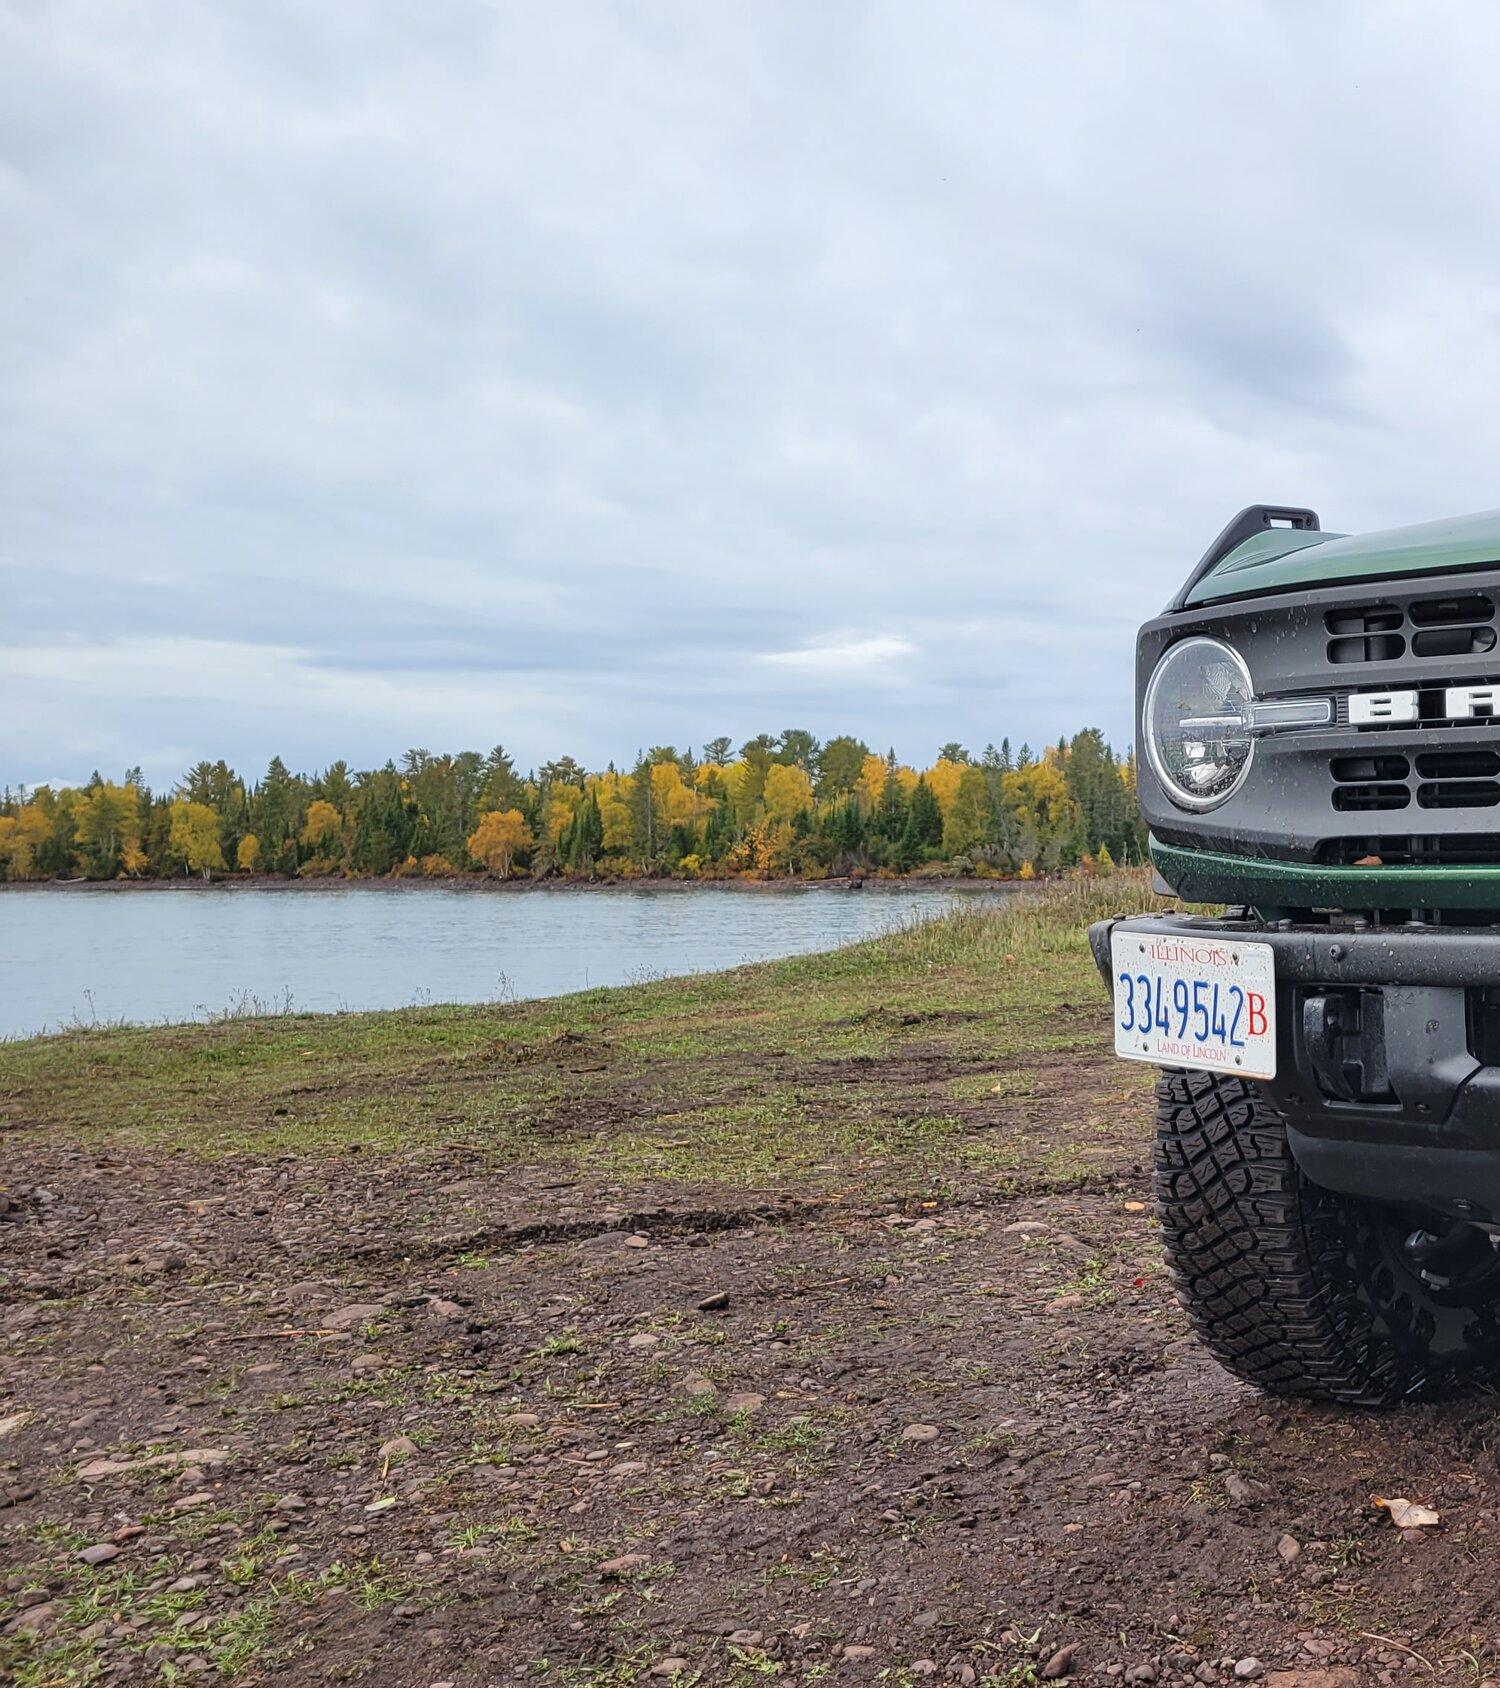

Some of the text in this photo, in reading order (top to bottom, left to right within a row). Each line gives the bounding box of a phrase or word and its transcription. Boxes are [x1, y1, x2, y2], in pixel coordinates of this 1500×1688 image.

[1151, 944, 1227, 966] ILLINOIS
[1157, 1040, 1227, 1061] LAND OF LINCOLN
